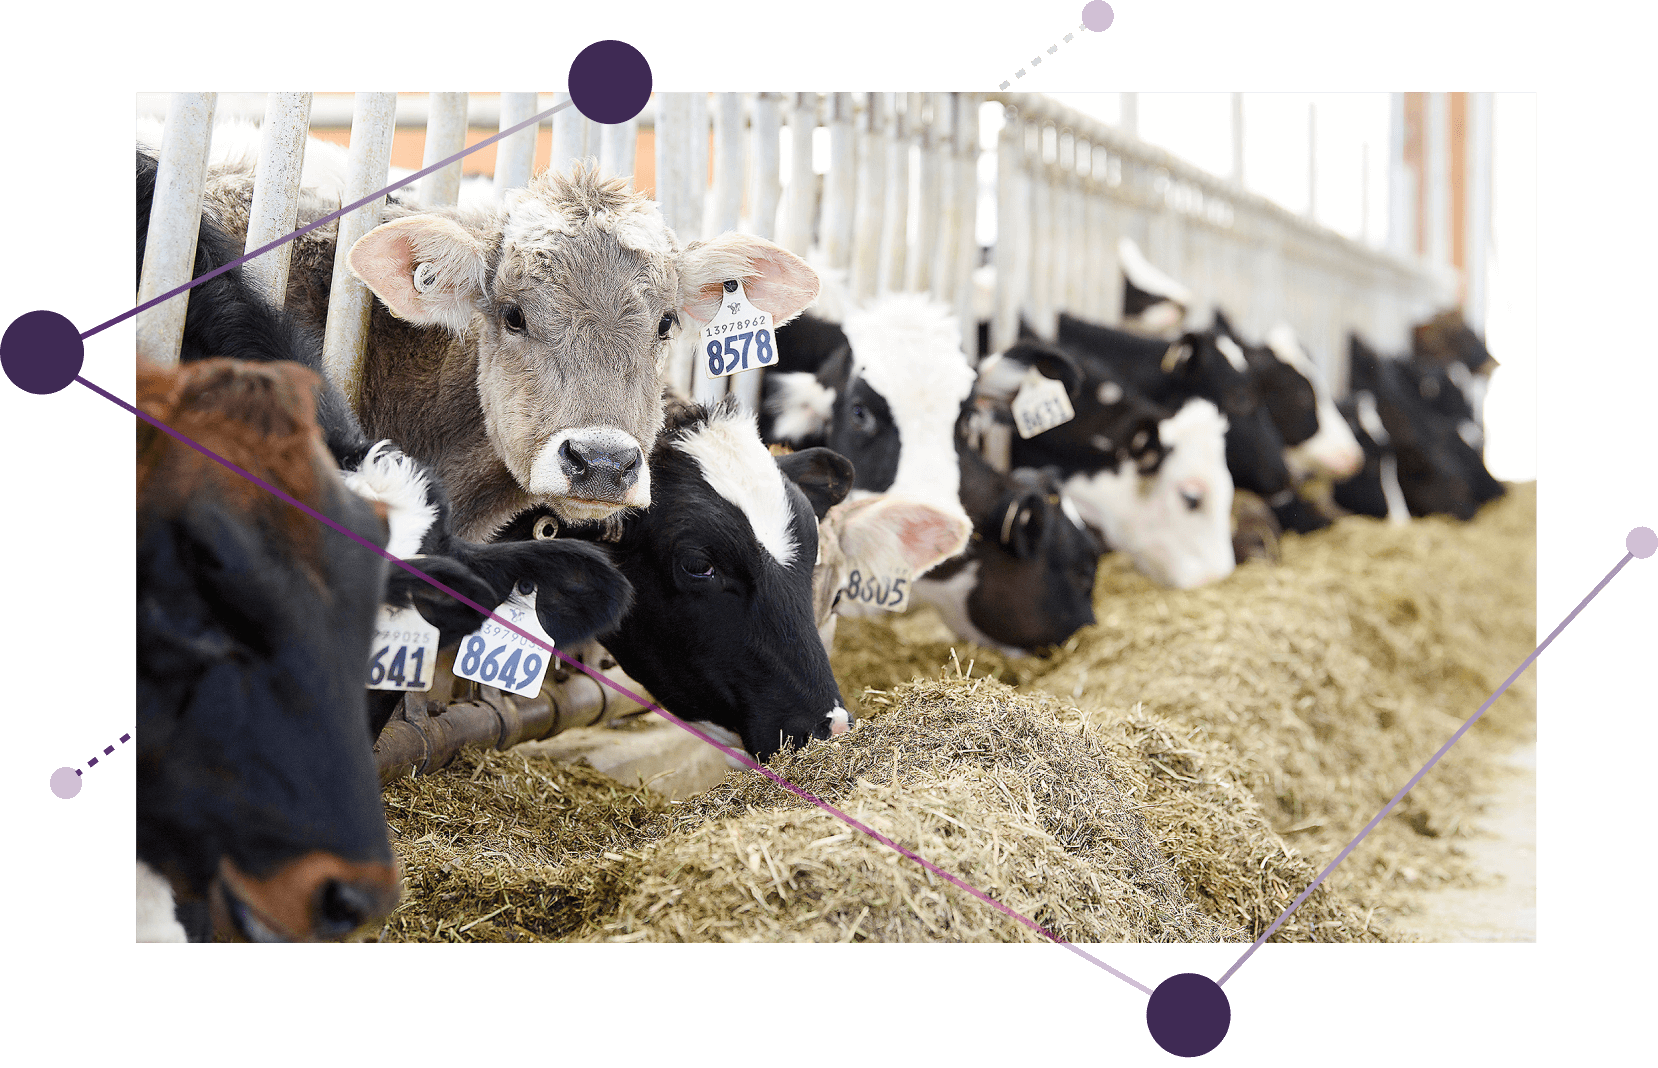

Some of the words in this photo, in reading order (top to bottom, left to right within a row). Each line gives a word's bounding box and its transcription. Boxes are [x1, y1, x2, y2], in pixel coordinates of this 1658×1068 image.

[706, 316, 766, 337] 13978962
[707, 329, 773, 376] 8578
[461, 635, 543, 691] 8649
